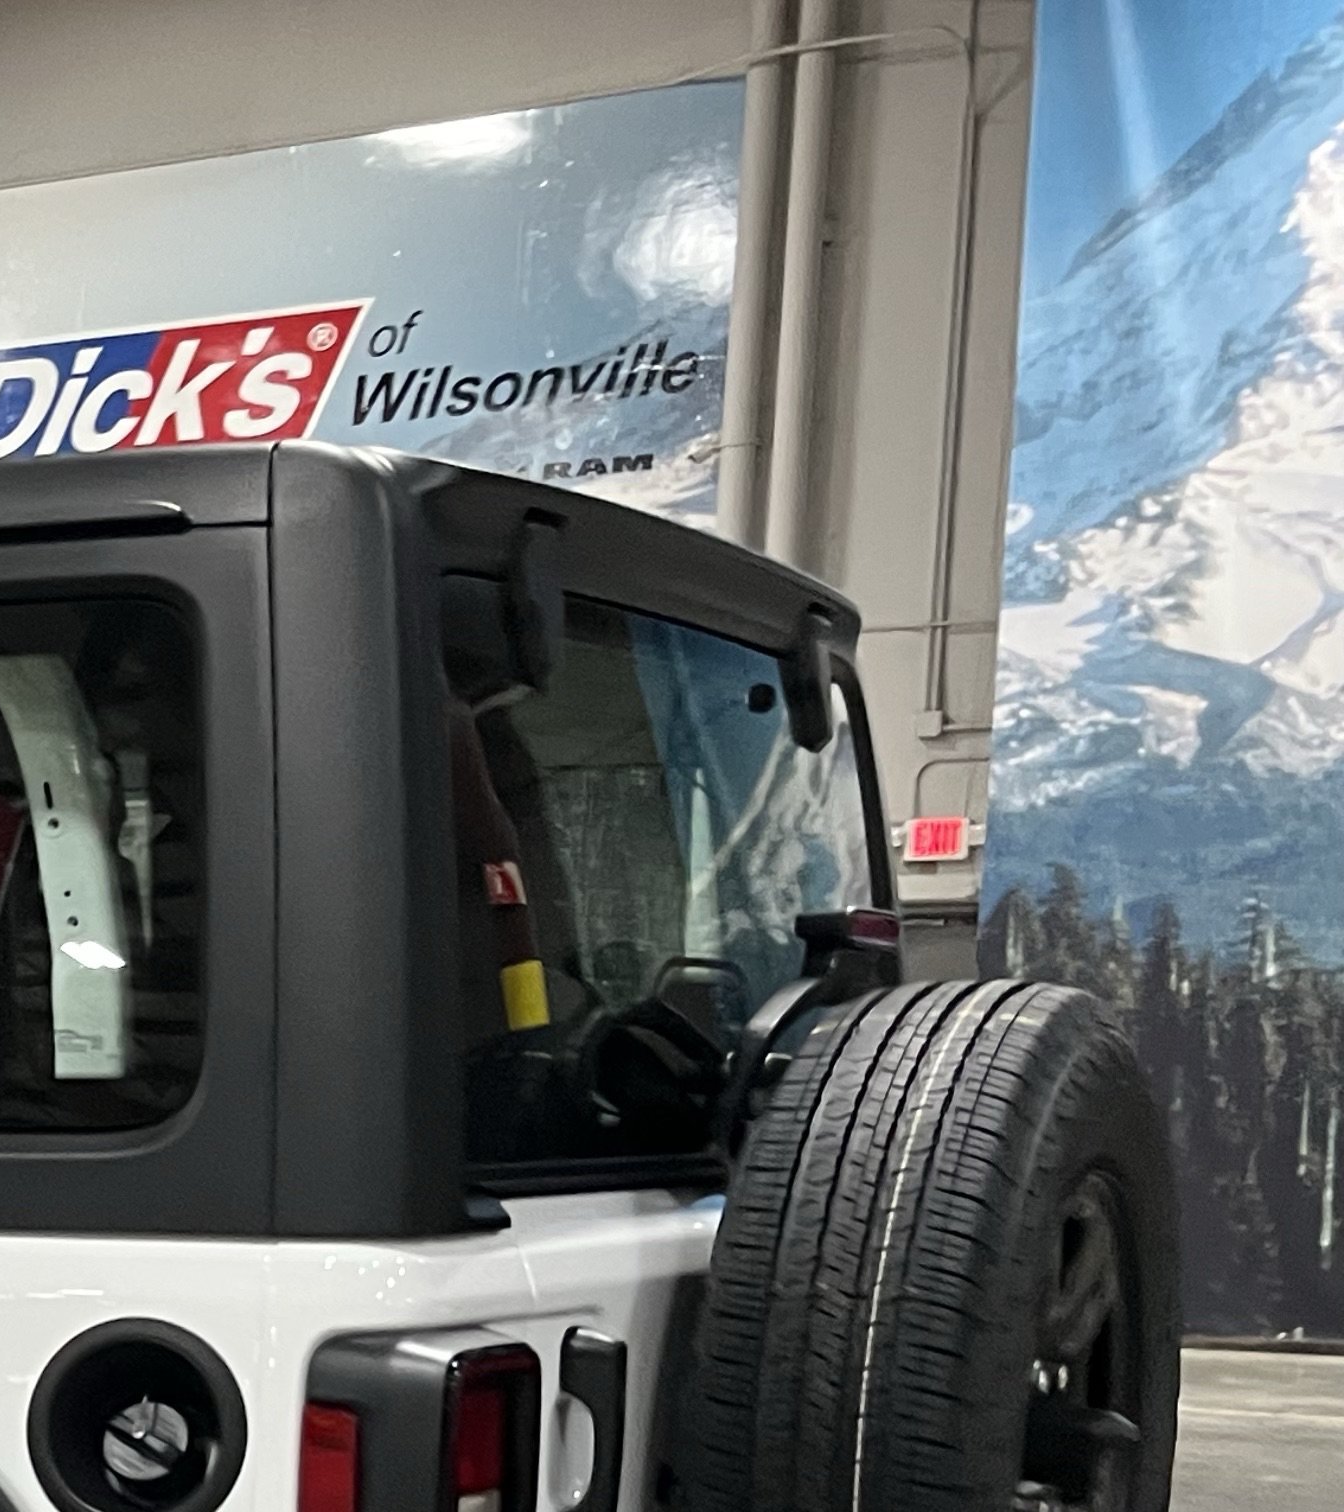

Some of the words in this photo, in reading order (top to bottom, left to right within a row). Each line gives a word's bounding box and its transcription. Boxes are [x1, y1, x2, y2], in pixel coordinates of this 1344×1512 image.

[368, 310, 423, 357] of
[352, 338, 699, 426] Wilsonville
[543, 453, 654, 480] RAM
[914, 822, 960, 856] EXIT
